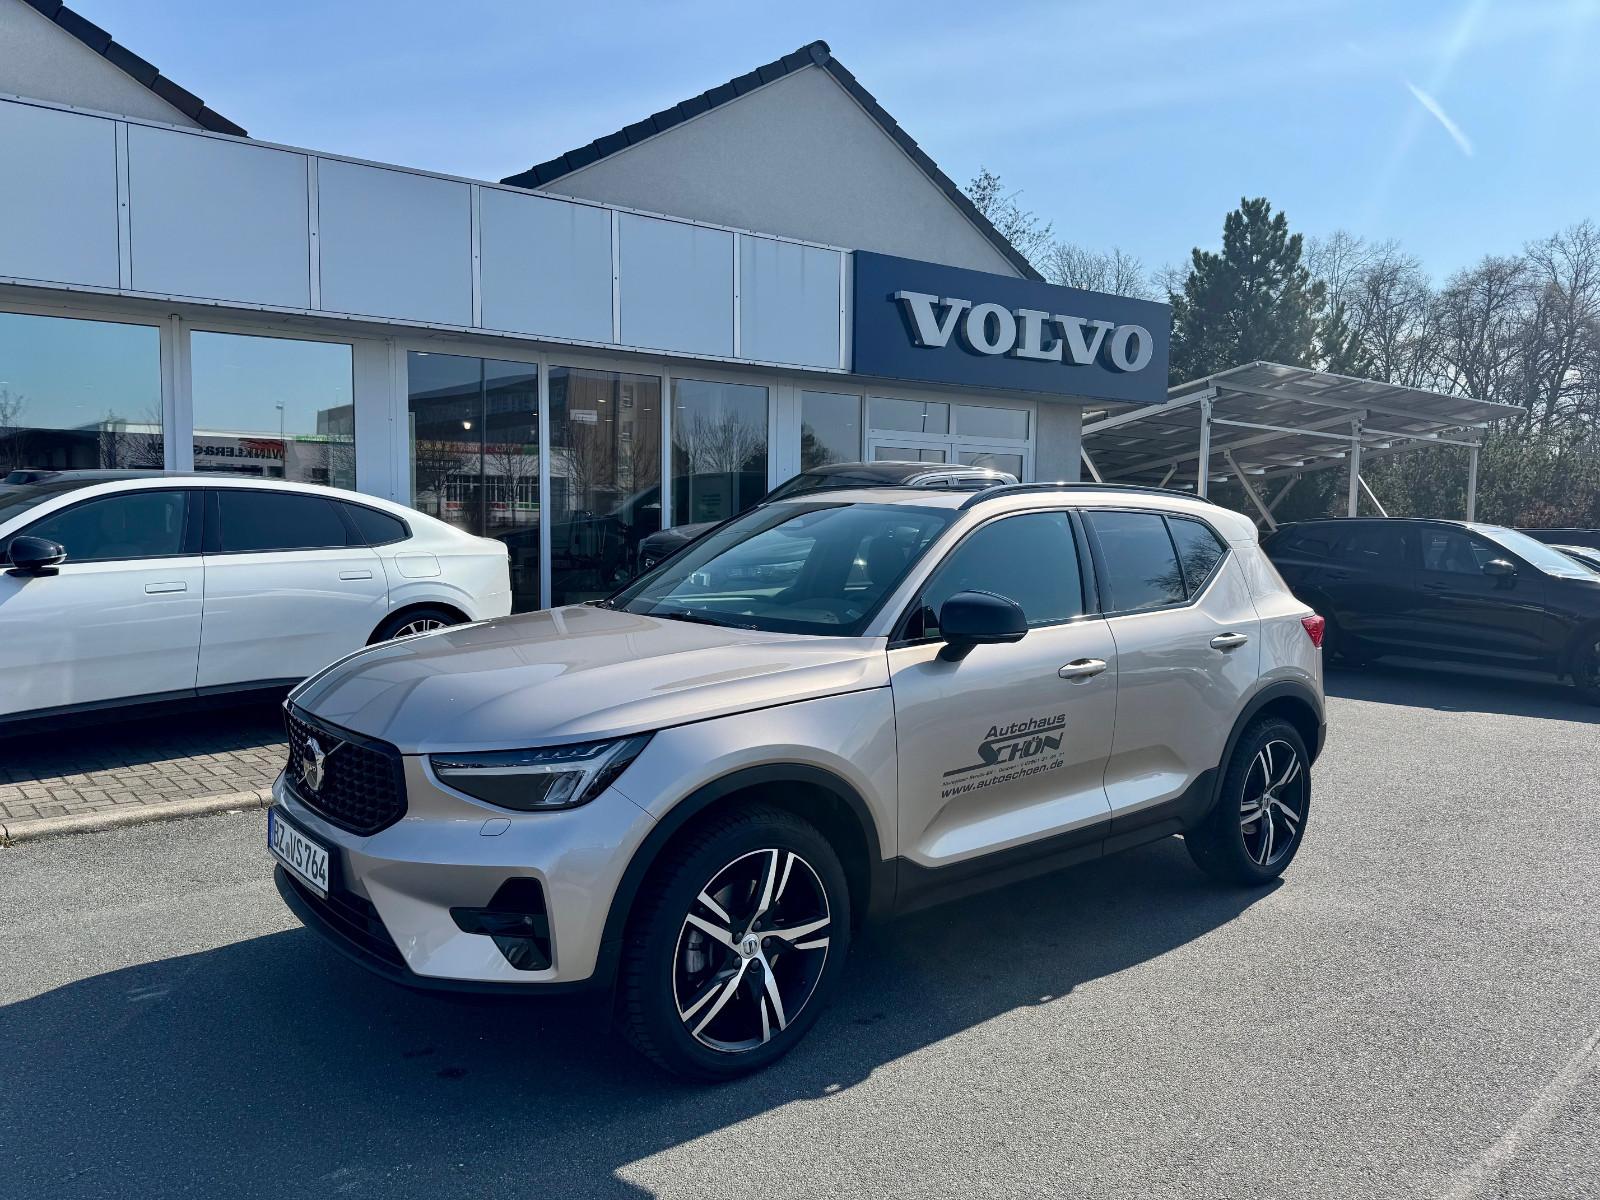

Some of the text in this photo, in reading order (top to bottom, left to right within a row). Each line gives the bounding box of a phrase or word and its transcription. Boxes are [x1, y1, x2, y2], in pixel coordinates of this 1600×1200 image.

[894, 290, 1153, 372] VOLVO
[984, 713, 1066, 739] Autohaus
[941, 759, 1064, 799] www.autoschoen.de
